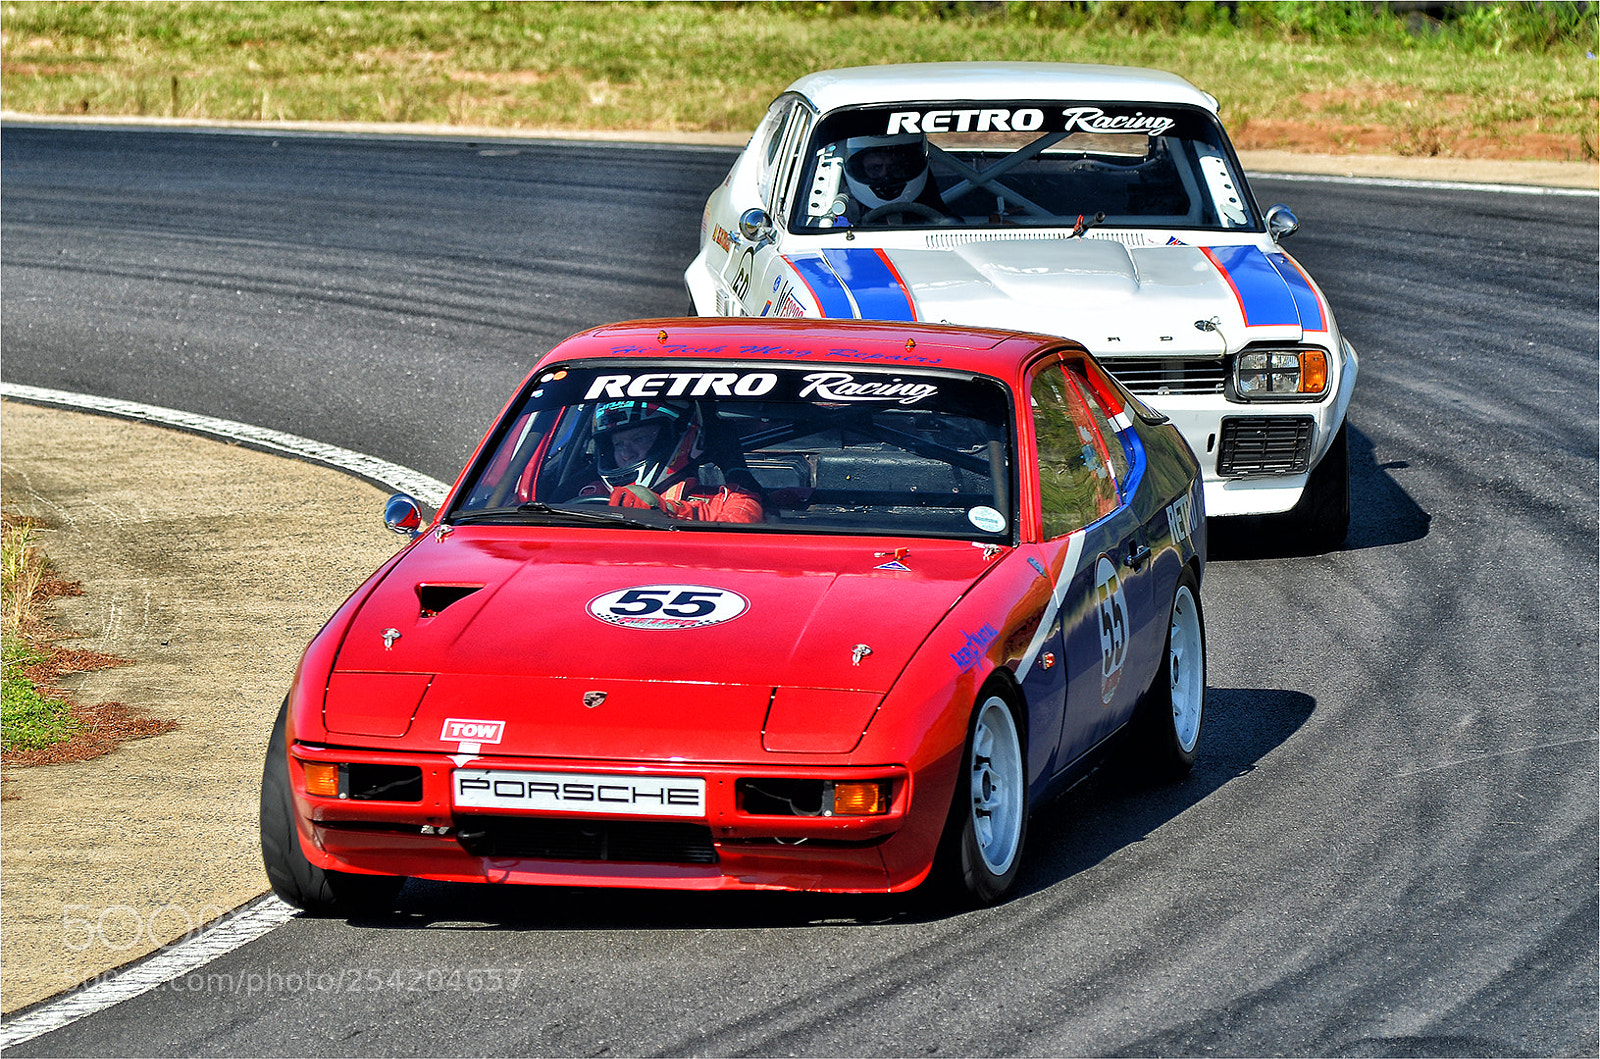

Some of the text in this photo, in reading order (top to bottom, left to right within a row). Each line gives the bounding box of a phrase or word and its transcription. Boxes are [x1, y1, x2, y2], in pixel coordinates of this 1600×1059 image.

[886, 106, 1175, 137] RETRO Racing
[825, 348, 942, 364] Repairs
[584, 372, 938, 404] RETRO Racing
[609, 590, 723, 617] 55
[1098, 574, 1126, 676] 55
[450, 722, 498, 739] TOW
[460, 777, 700, 806] PORSCHE
